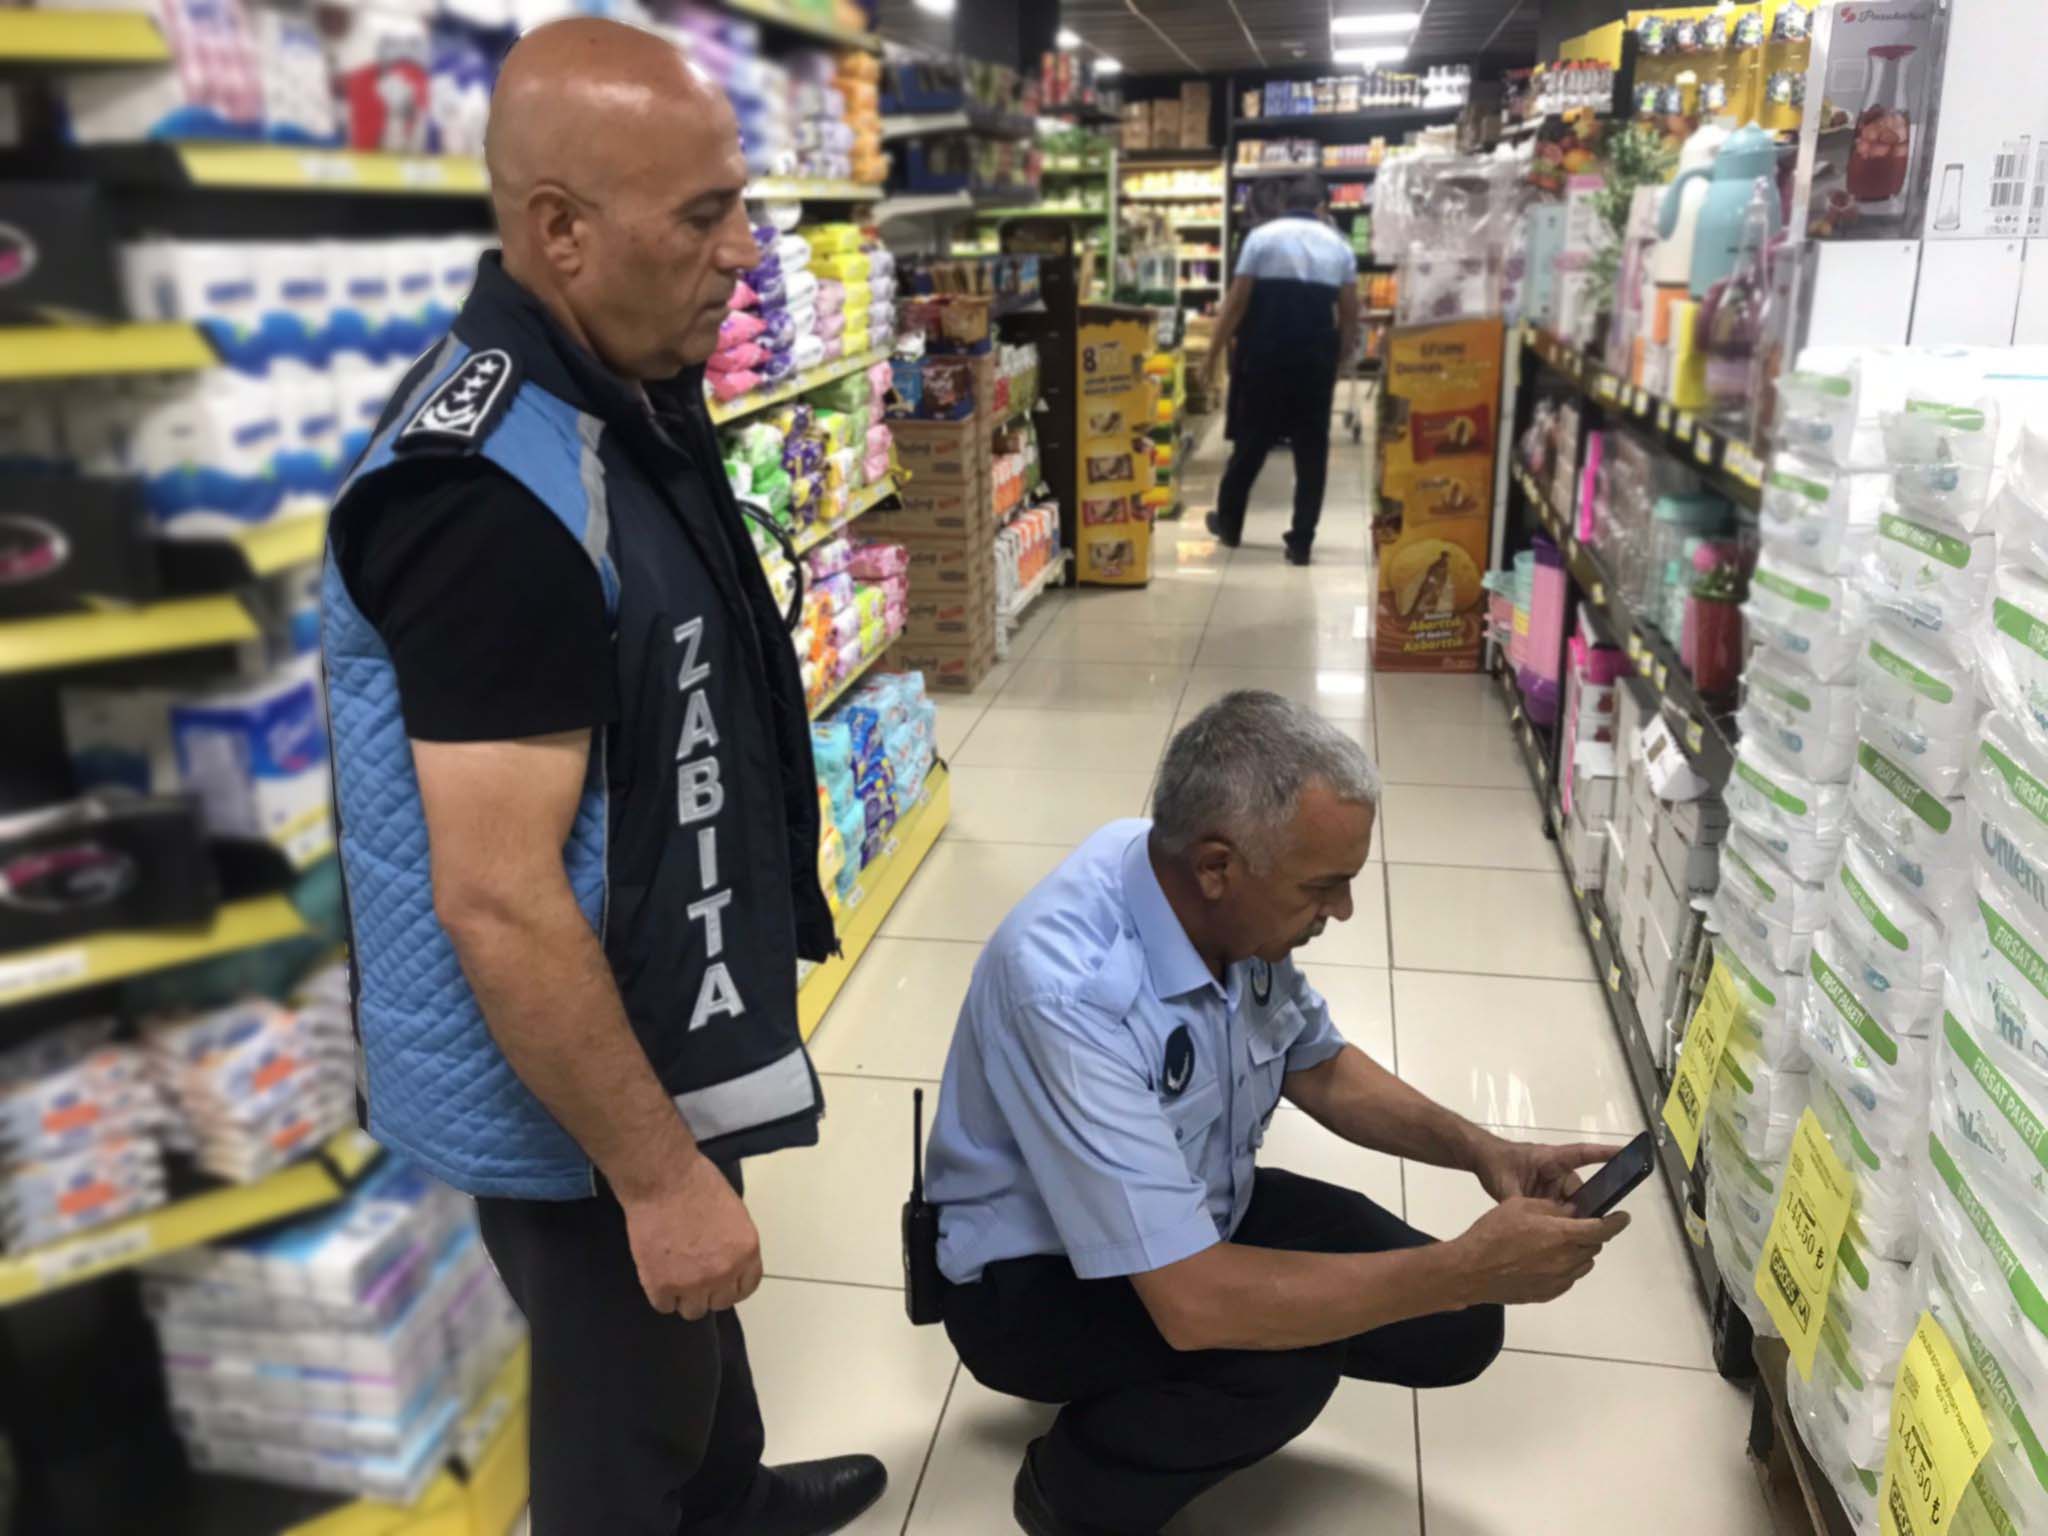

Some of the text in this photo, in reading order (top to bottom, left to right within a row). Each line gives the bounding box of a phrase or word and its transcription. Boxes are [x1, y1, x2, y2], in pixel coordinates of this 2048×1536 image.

[673, 616, 746, 1032] ZABITA
[1994, 925, 2031, 969] FIRSAT
[1975, 1057, 2008, 1104] FIRSAT
